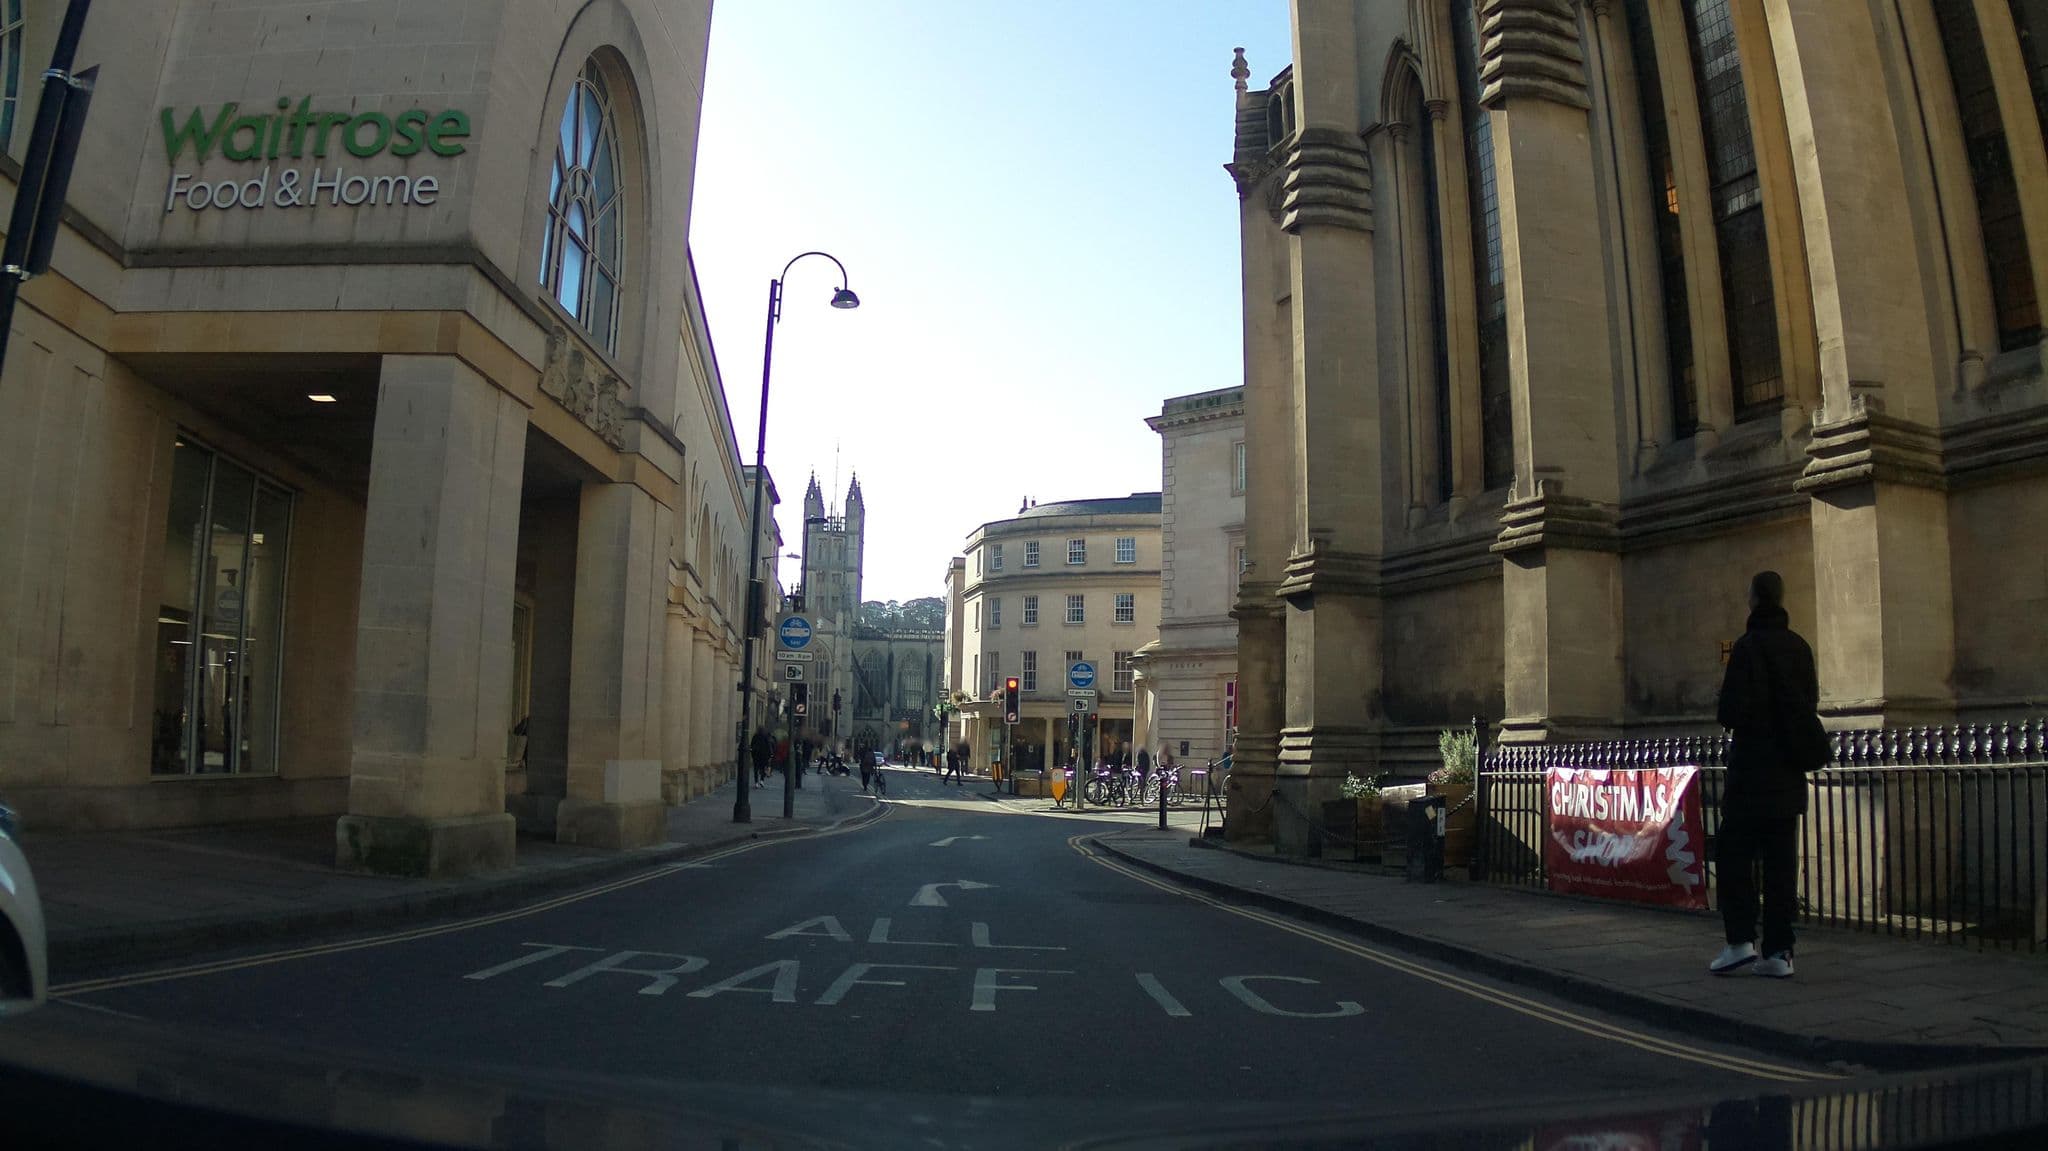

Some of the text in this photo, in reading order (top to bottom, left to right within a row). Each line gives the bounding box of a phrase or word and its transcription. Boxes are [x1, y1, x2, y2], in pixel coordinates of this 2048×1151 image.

[161, 95, 470, 165] Waitrose
[167, 166, 439, 212] Food & Home
[1552, 782, 1668, 822] CHRISTMAS
[764, 915, 1067, 950] ALL
[462, 942, 1365, 1018] TRAFFIC
